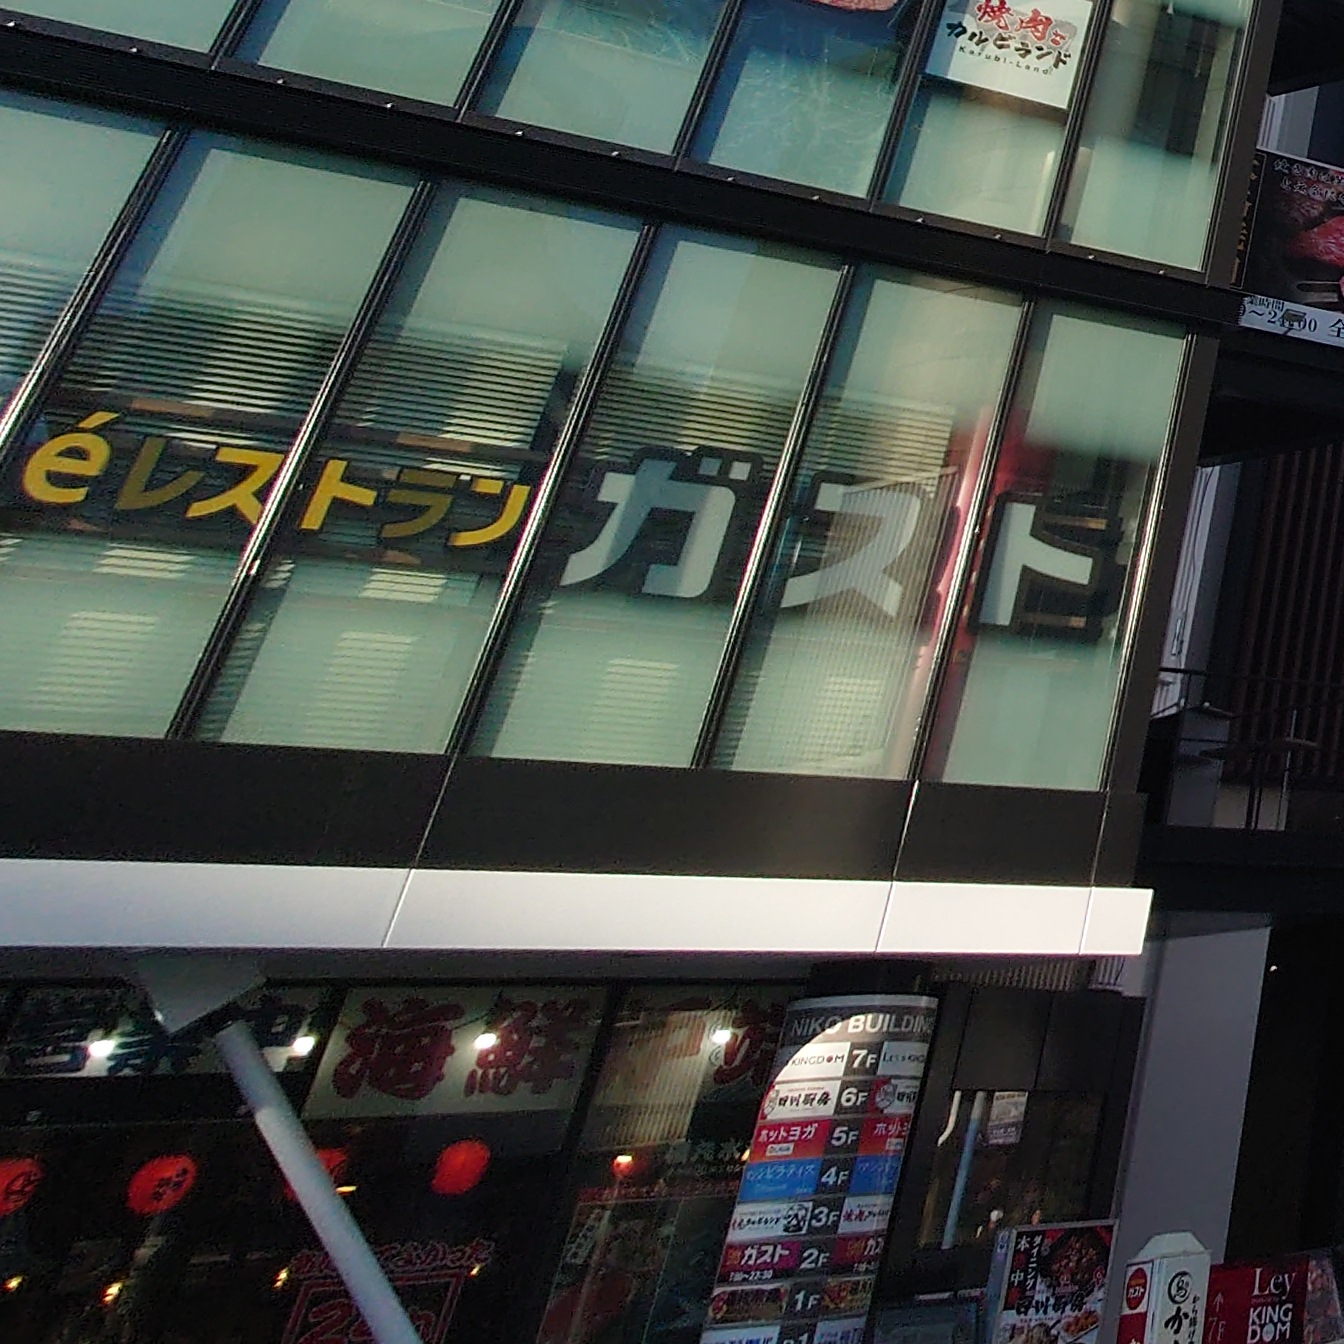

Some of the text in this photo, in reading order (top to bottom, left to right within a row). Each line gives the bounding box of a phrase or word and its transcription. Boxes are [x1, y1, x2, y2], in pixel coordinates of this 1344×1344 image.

[946, 20, 1072, 70] カルビランド
[561, 457, 1097, 627] ガスト
[851, 1048, 877, 1069] 7F
[841, 1088, 870, 1107] 6F
[757, 1123, 818, 1142] ホットヨガ
[831, 1126, 860, 1146] 5F
[821, 1166, 849, 1186] 4F
[811, 1207, 840, 1228] 3F
[740, 1244, 790, 1266] ガスト
[800, 1247, 830, 1269] 2F
[1025, 1235, 1043, 1290] ダイニング
[1252, 1267, 1298, 1300] Ley
[794, 1292, 821, 1311] 1F
[1249, 1303, 1293, 1325] KING
